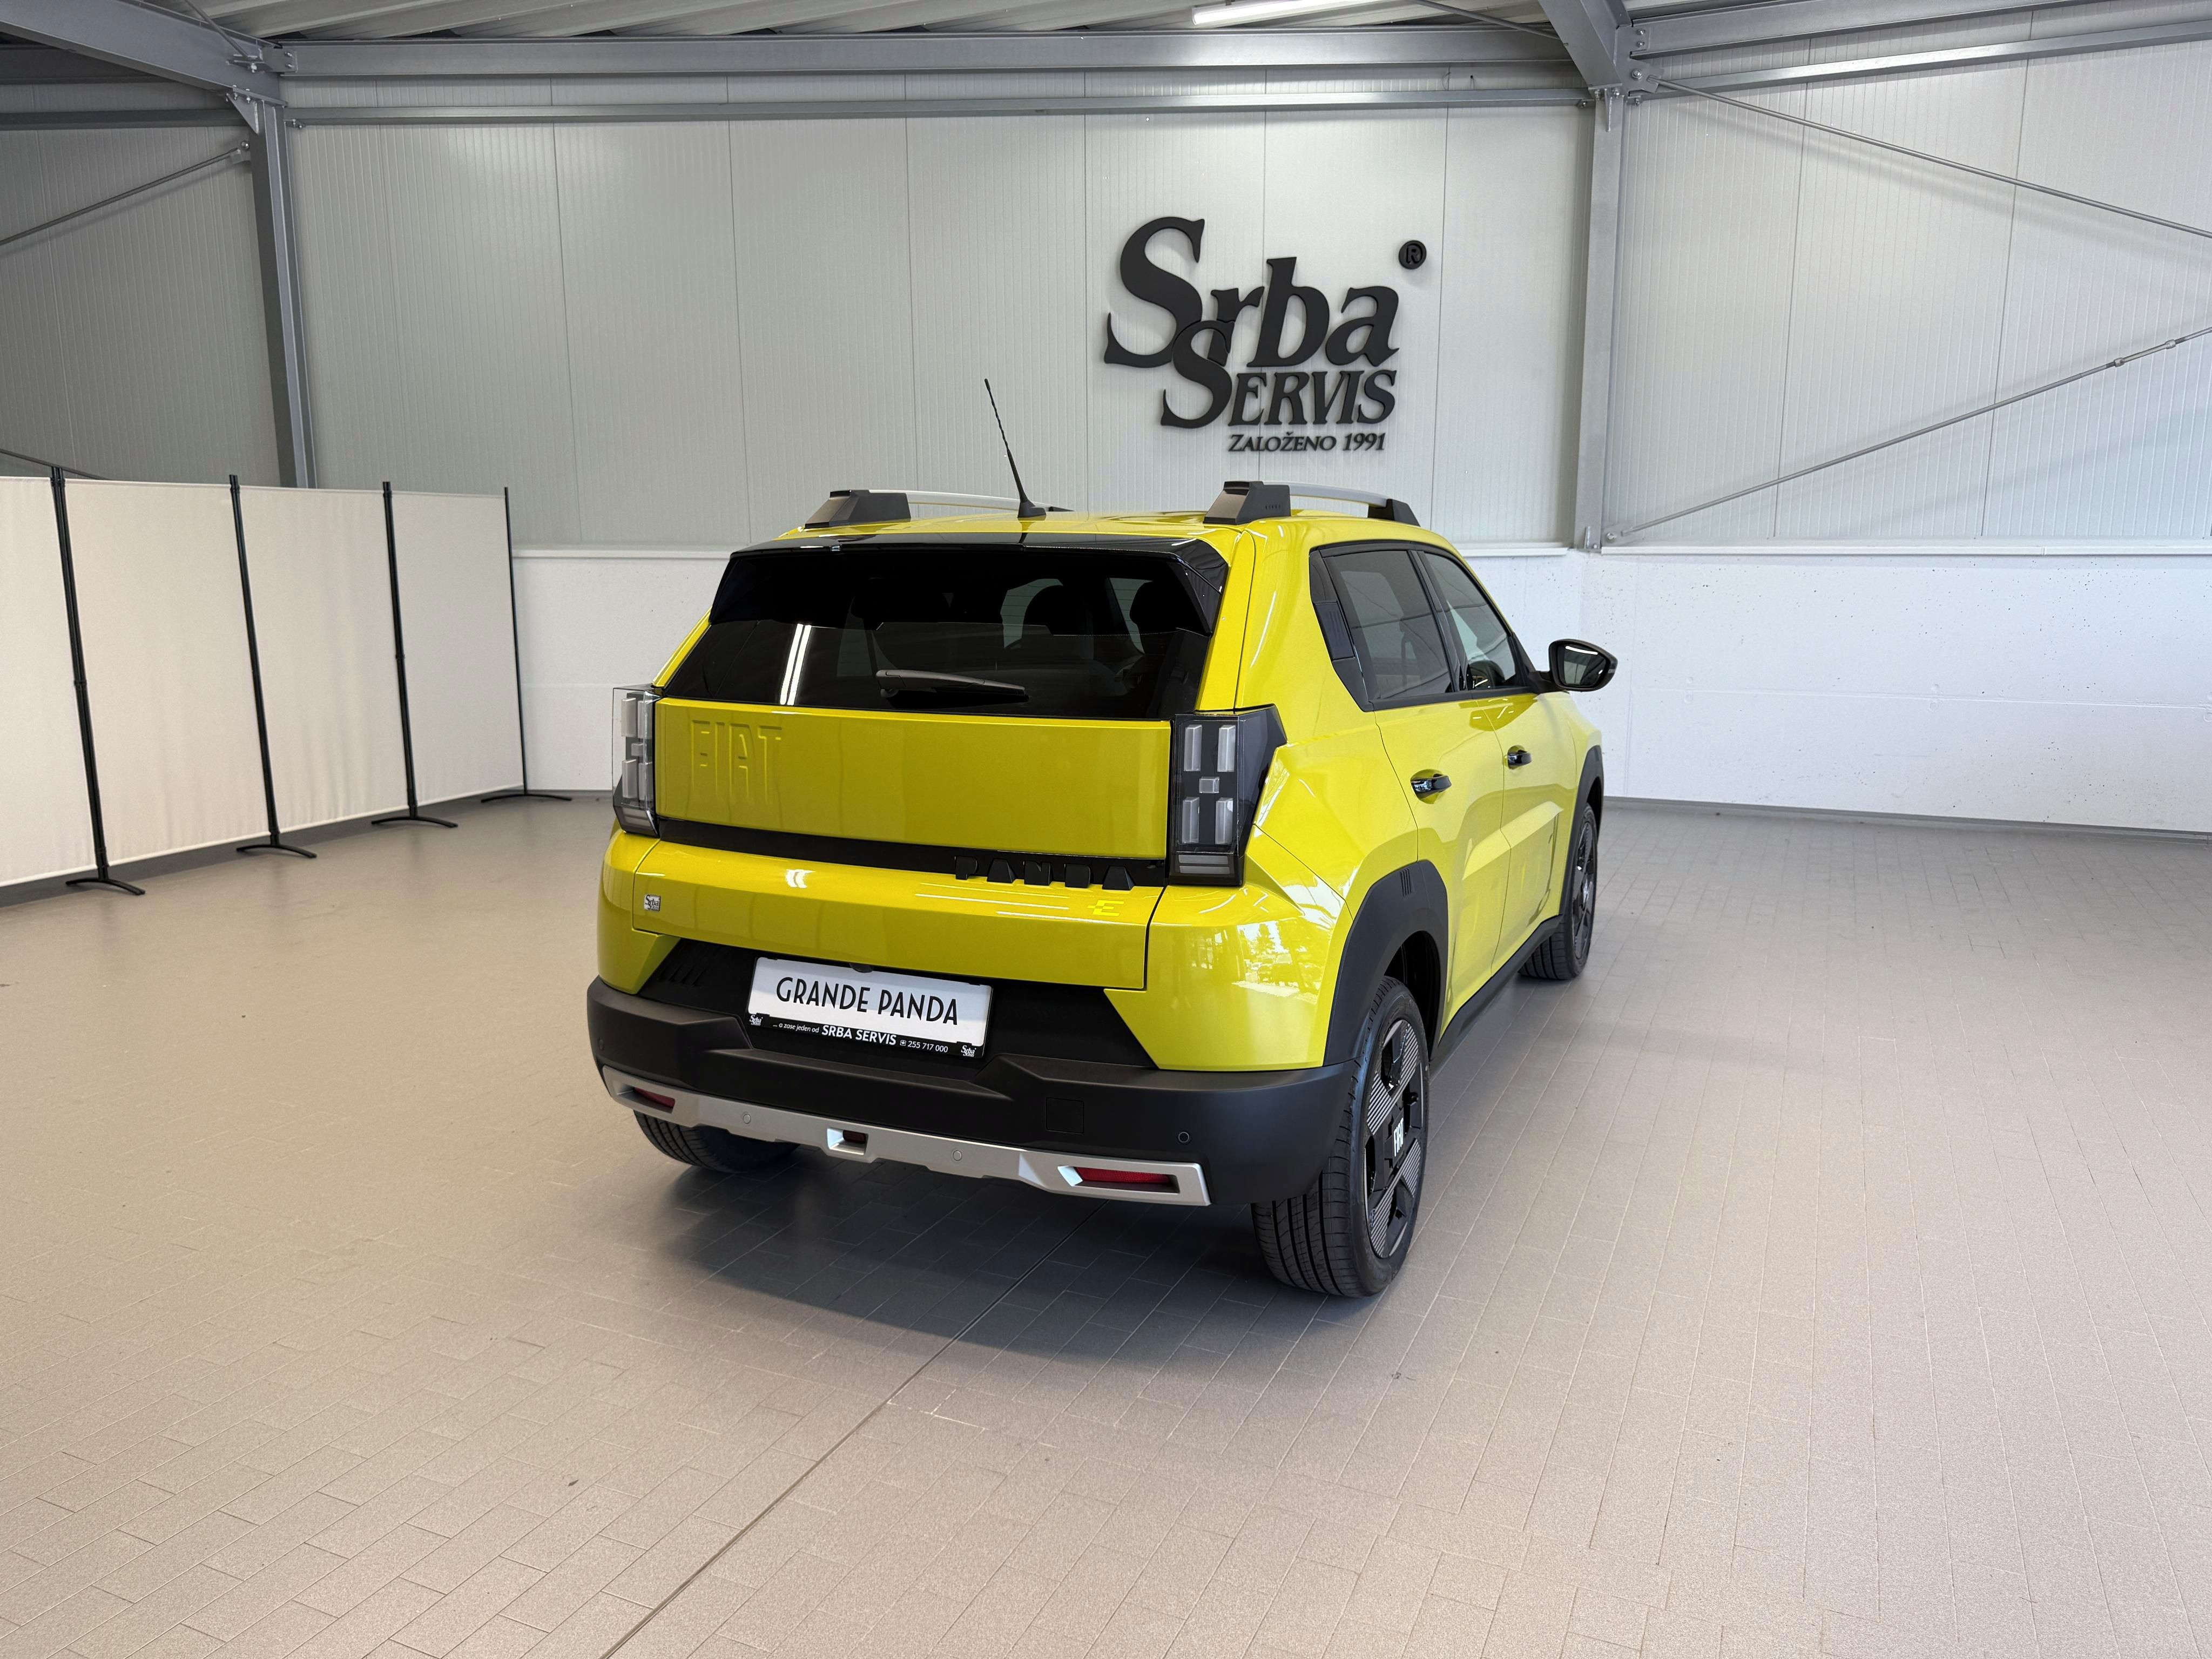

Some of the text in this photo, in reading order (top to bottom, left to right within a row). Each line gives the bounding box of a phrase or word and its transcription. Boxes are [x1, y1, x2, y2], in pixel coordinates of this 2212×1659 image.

[1104, 217, 1400, 368] Srba
[1161, 320, 1397, 429] SERVIS
[1228, 432, 1386, 452] ZALOŽENO 1991
[691, 720, 783, 805] FIAT
[954, 855, 1135, 891] PANDA
[777, 976, 957, 1025] GRANDE PANDA
[821, 1025, 853, 1040] SRBA
[855, 1029, 897, 1046] SERVIS
[907, 1041, 921, 1049] 255
[922, 1042, 935, 1050] 717
[935, 1044, 948, 1053] 000
[1393, 1117, 1404, 1157] FIAT
